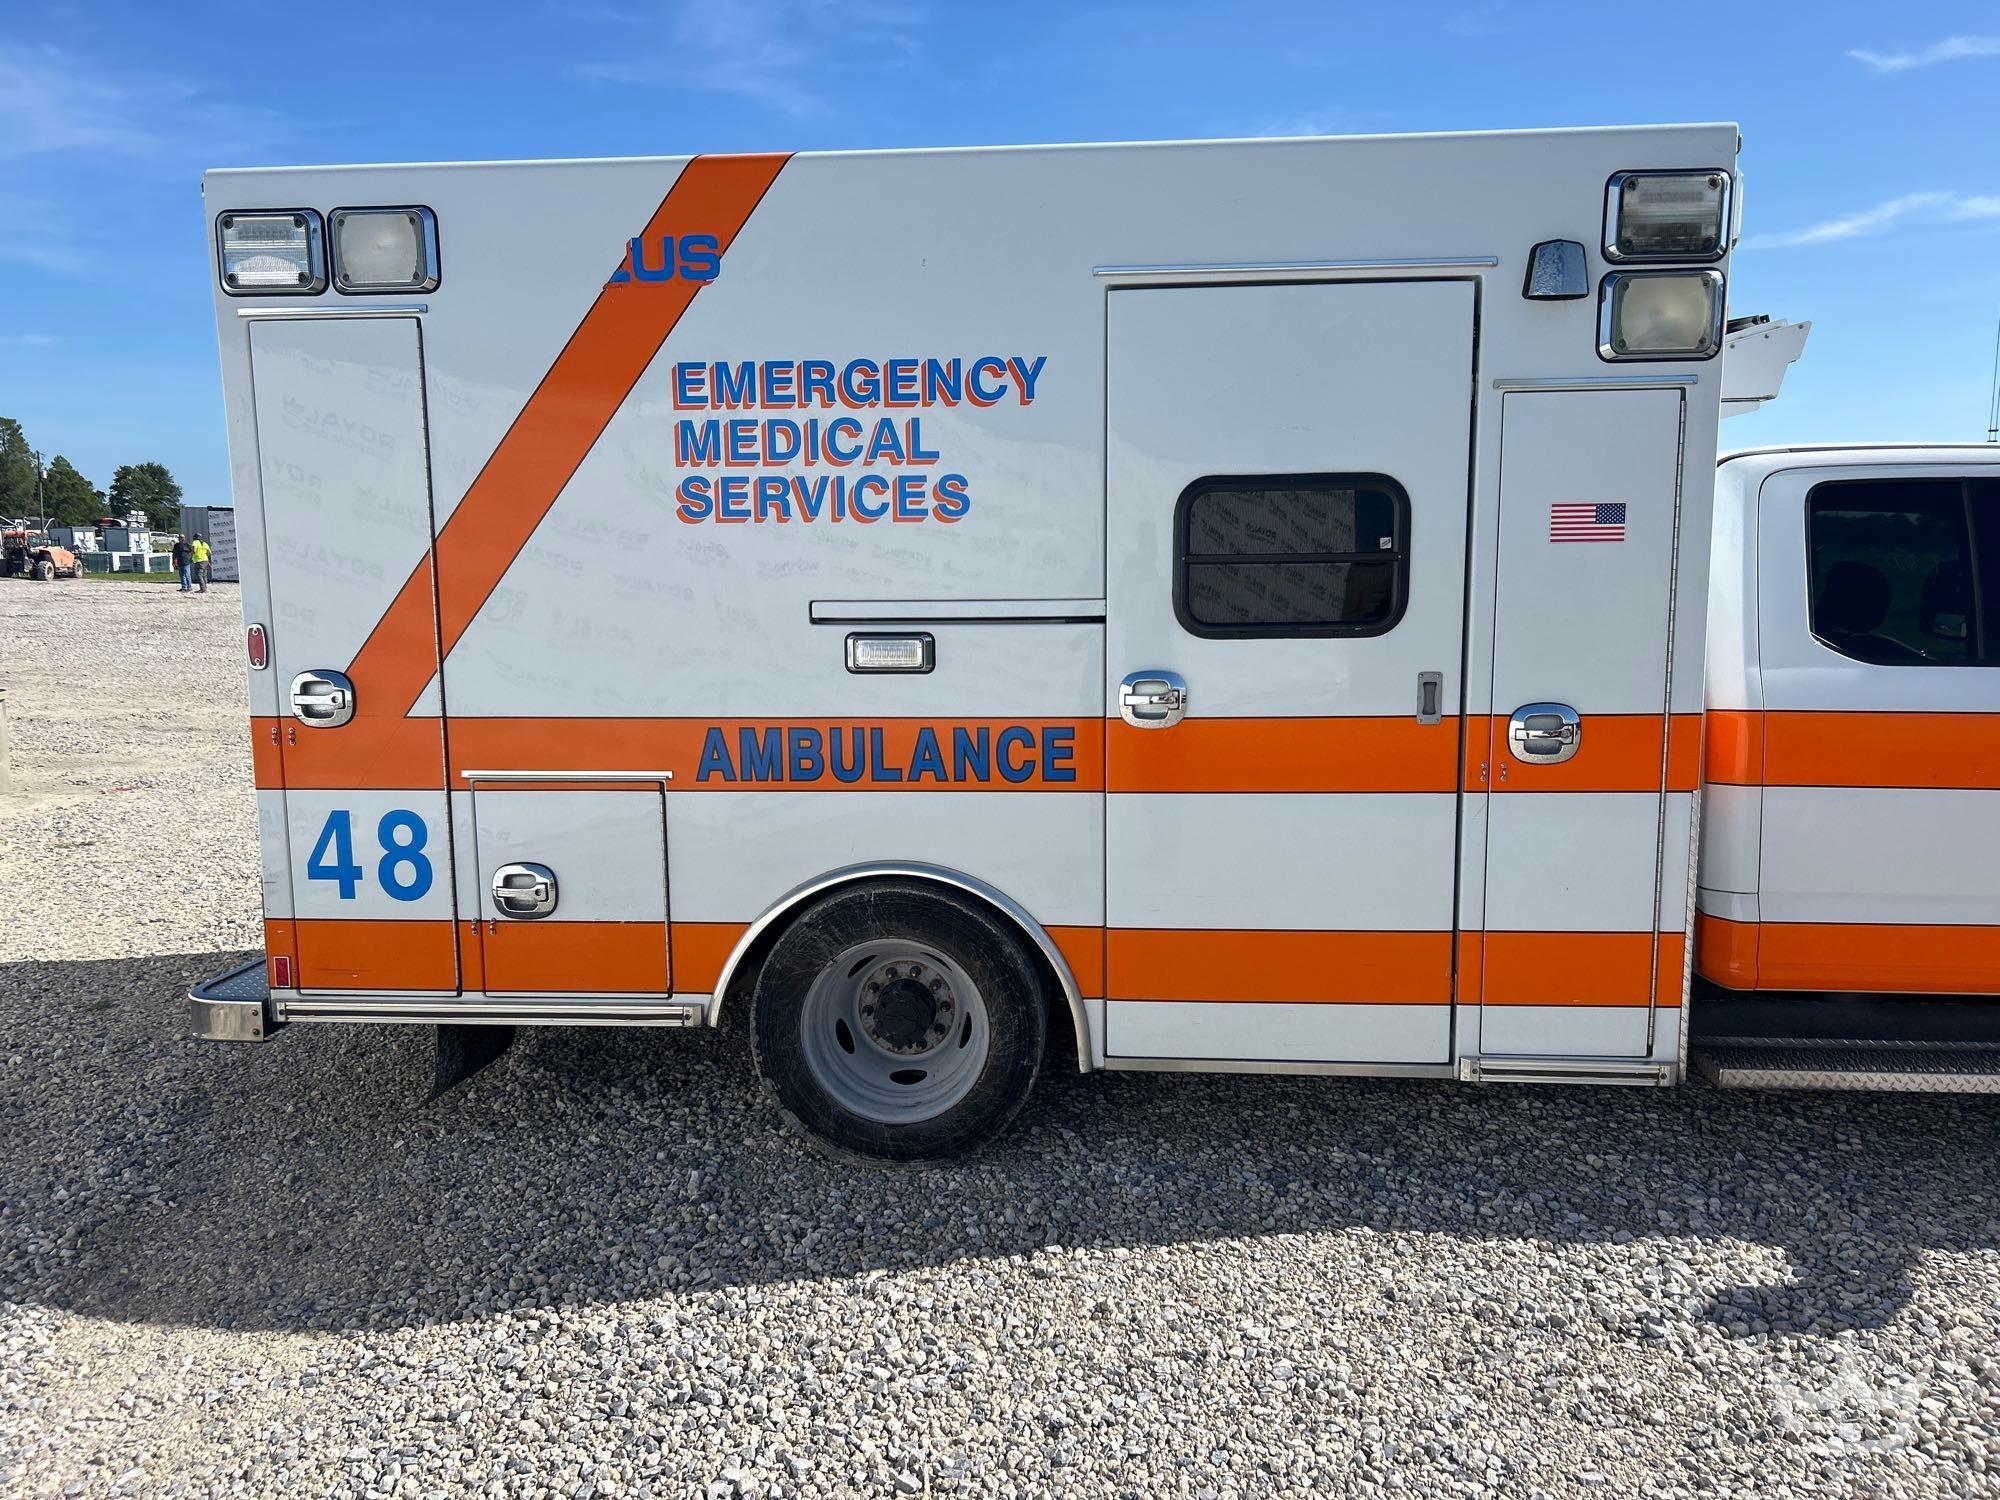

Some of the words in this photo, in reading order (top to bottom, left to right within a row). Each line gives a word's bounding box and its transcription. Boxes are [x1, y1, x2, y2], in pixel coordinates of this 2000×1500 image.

[608, 234, 721, 286] US
[671, 356, 1048, 411] EMERGENCY
[674, 417, 940, 468] MEDICAL
[676, 473, 971, 525] SERVICES
[695, 727, 1077, 783] AMBULANCE
[307, 809, 433, 902] 48
